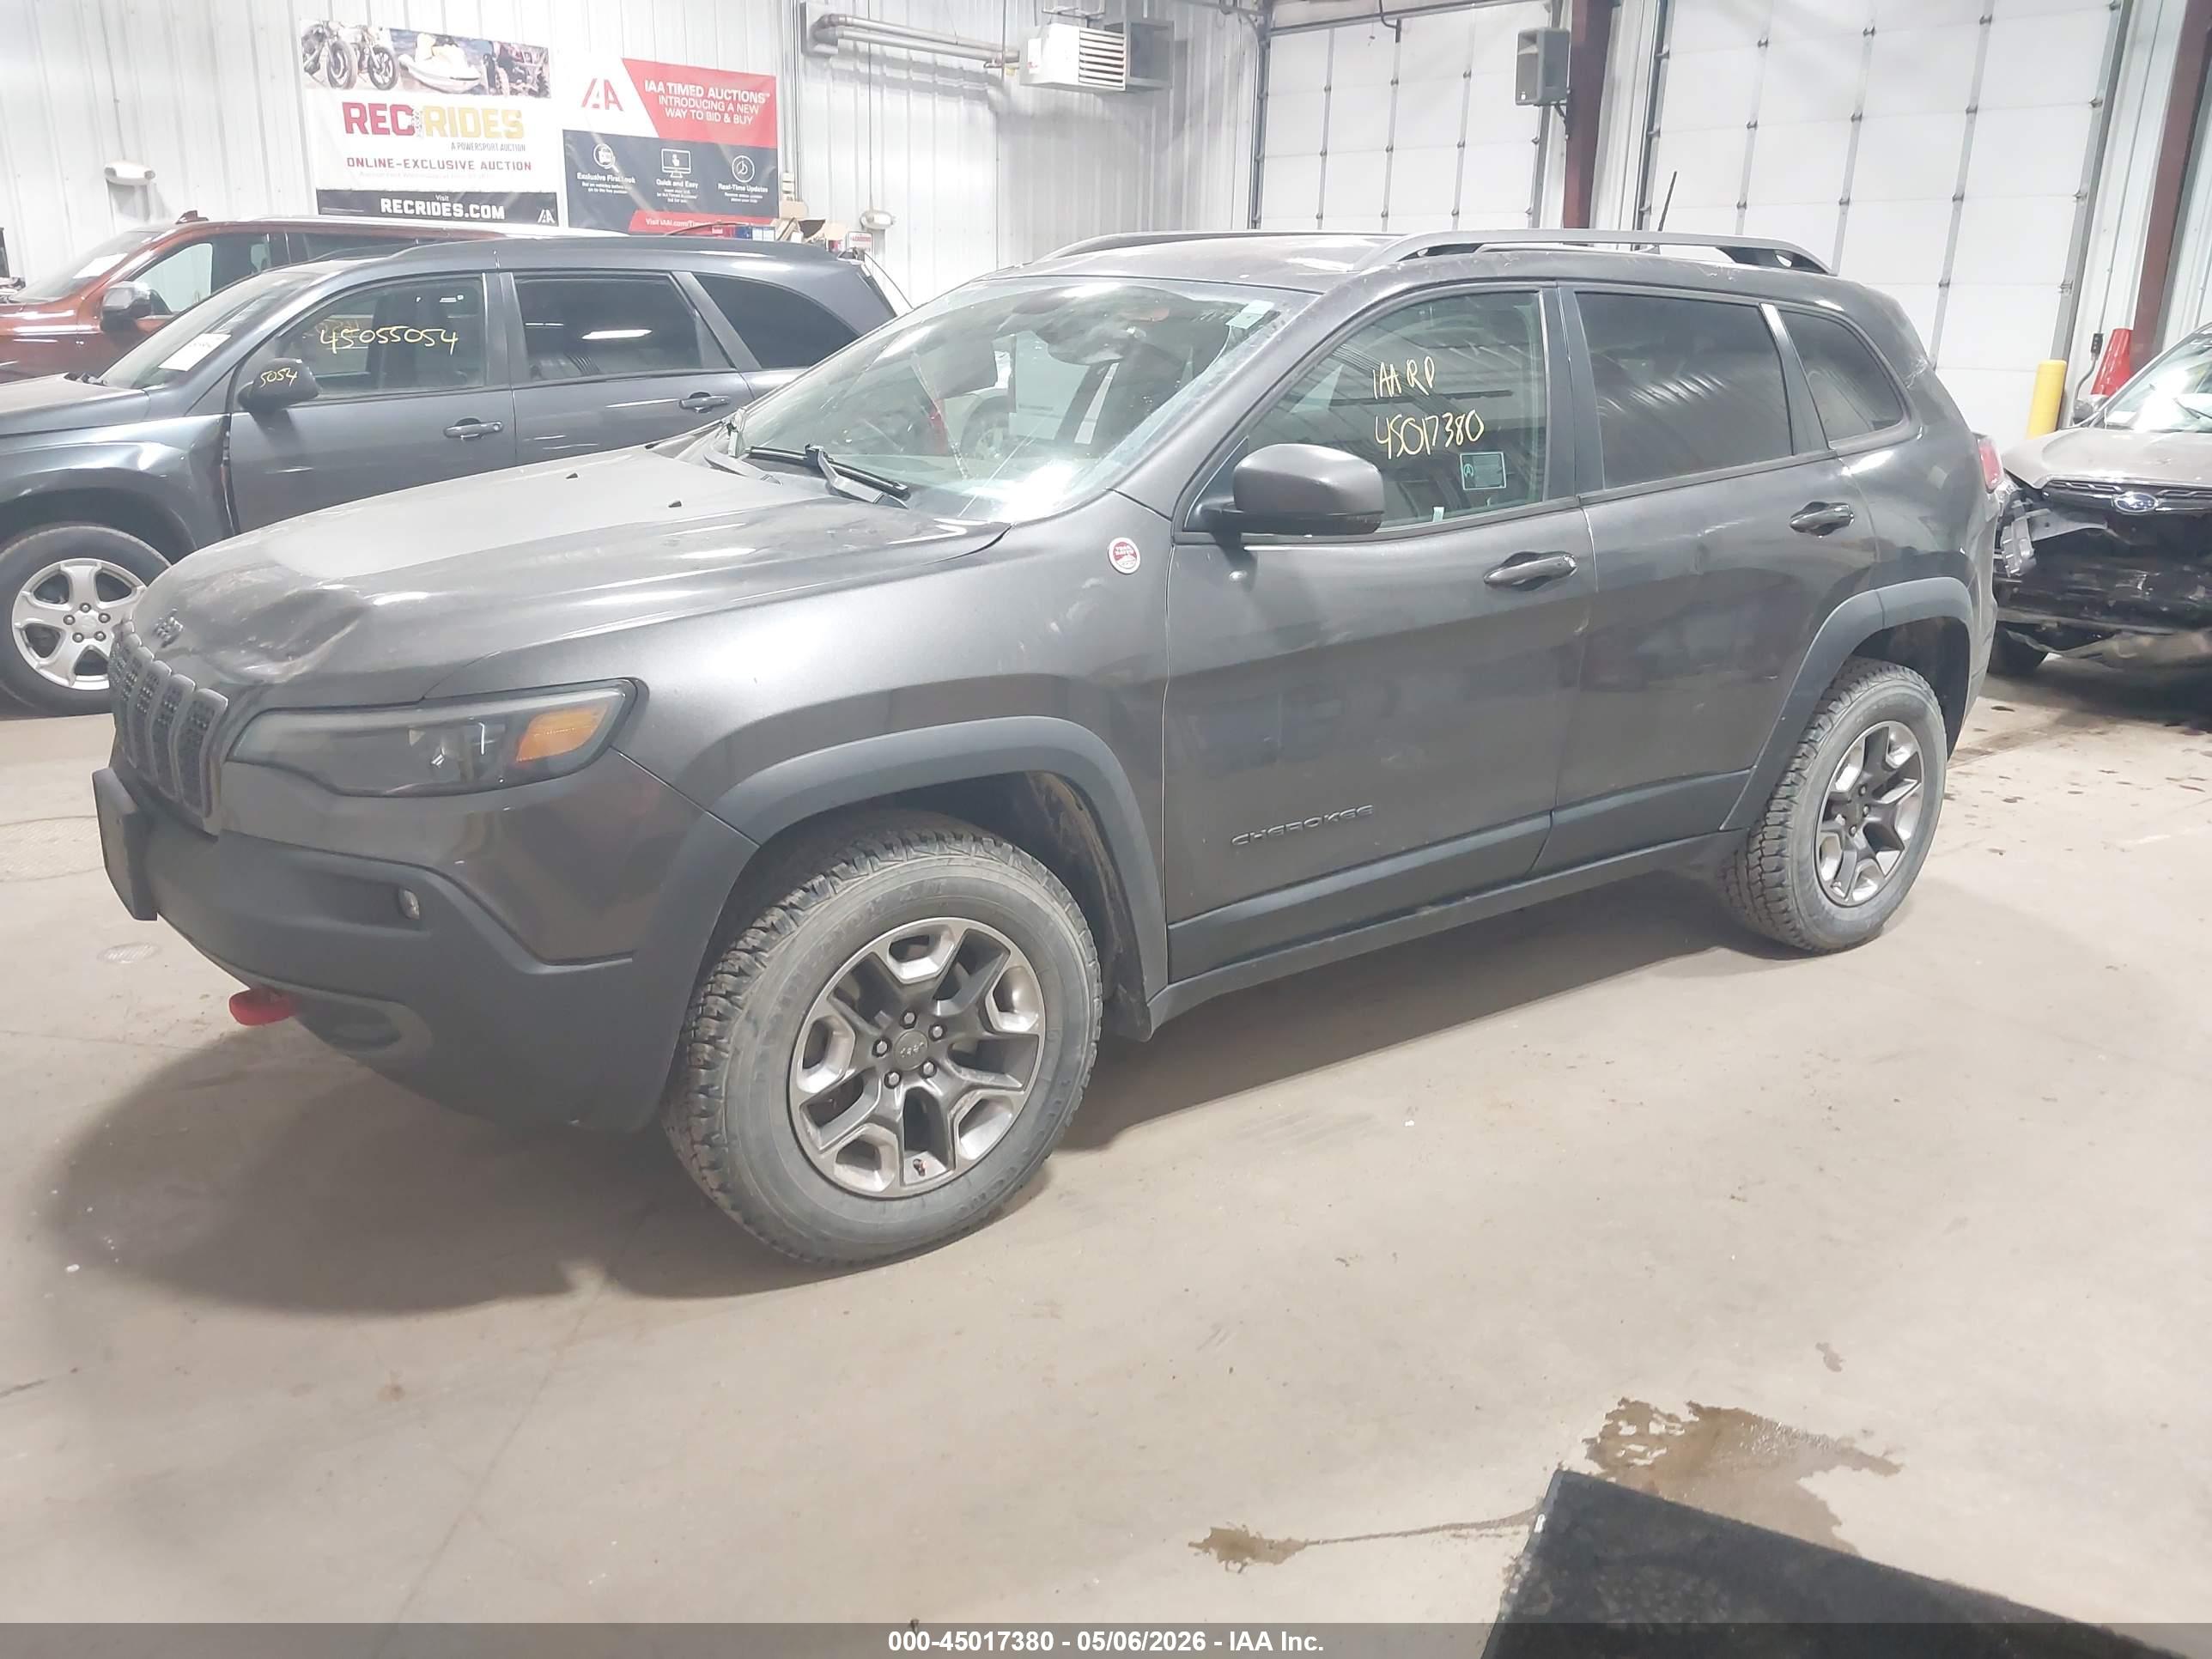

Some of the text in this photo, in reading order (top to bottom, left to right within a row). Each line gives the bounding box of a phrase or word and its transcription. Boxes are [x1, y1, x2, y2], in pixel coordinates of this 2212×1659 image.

[645, 80, 665, 94] IAA
[666, 82, 704, 98] TIMED
[659, 95, 759, 114] INTRODUCING A NEW
[342, 101, 416, 136] REC
[422, 105, 525, 139] RIDES
[665, 107, 754, 125] WAY TO BID & BUY
[451, 142, 526, 152] A POWERSPORT AUCTION
[347, 156, 532, 172] ONLINE-EXCLUSIVE AUCTION
[656, 178, 672, 186] Quick
[685, 180, 699, 189] Easy
[380, 198, 505, 220] RECRIDES.COM
[319, 325, 459, 356] 45055054
[260, 367, 298, 387] 5054
[1373, 362, 1402, 399] IAA
[1375, 409, 1485, 460] 45017380
[1231, 804, 1373, 846] CHEROKEE
